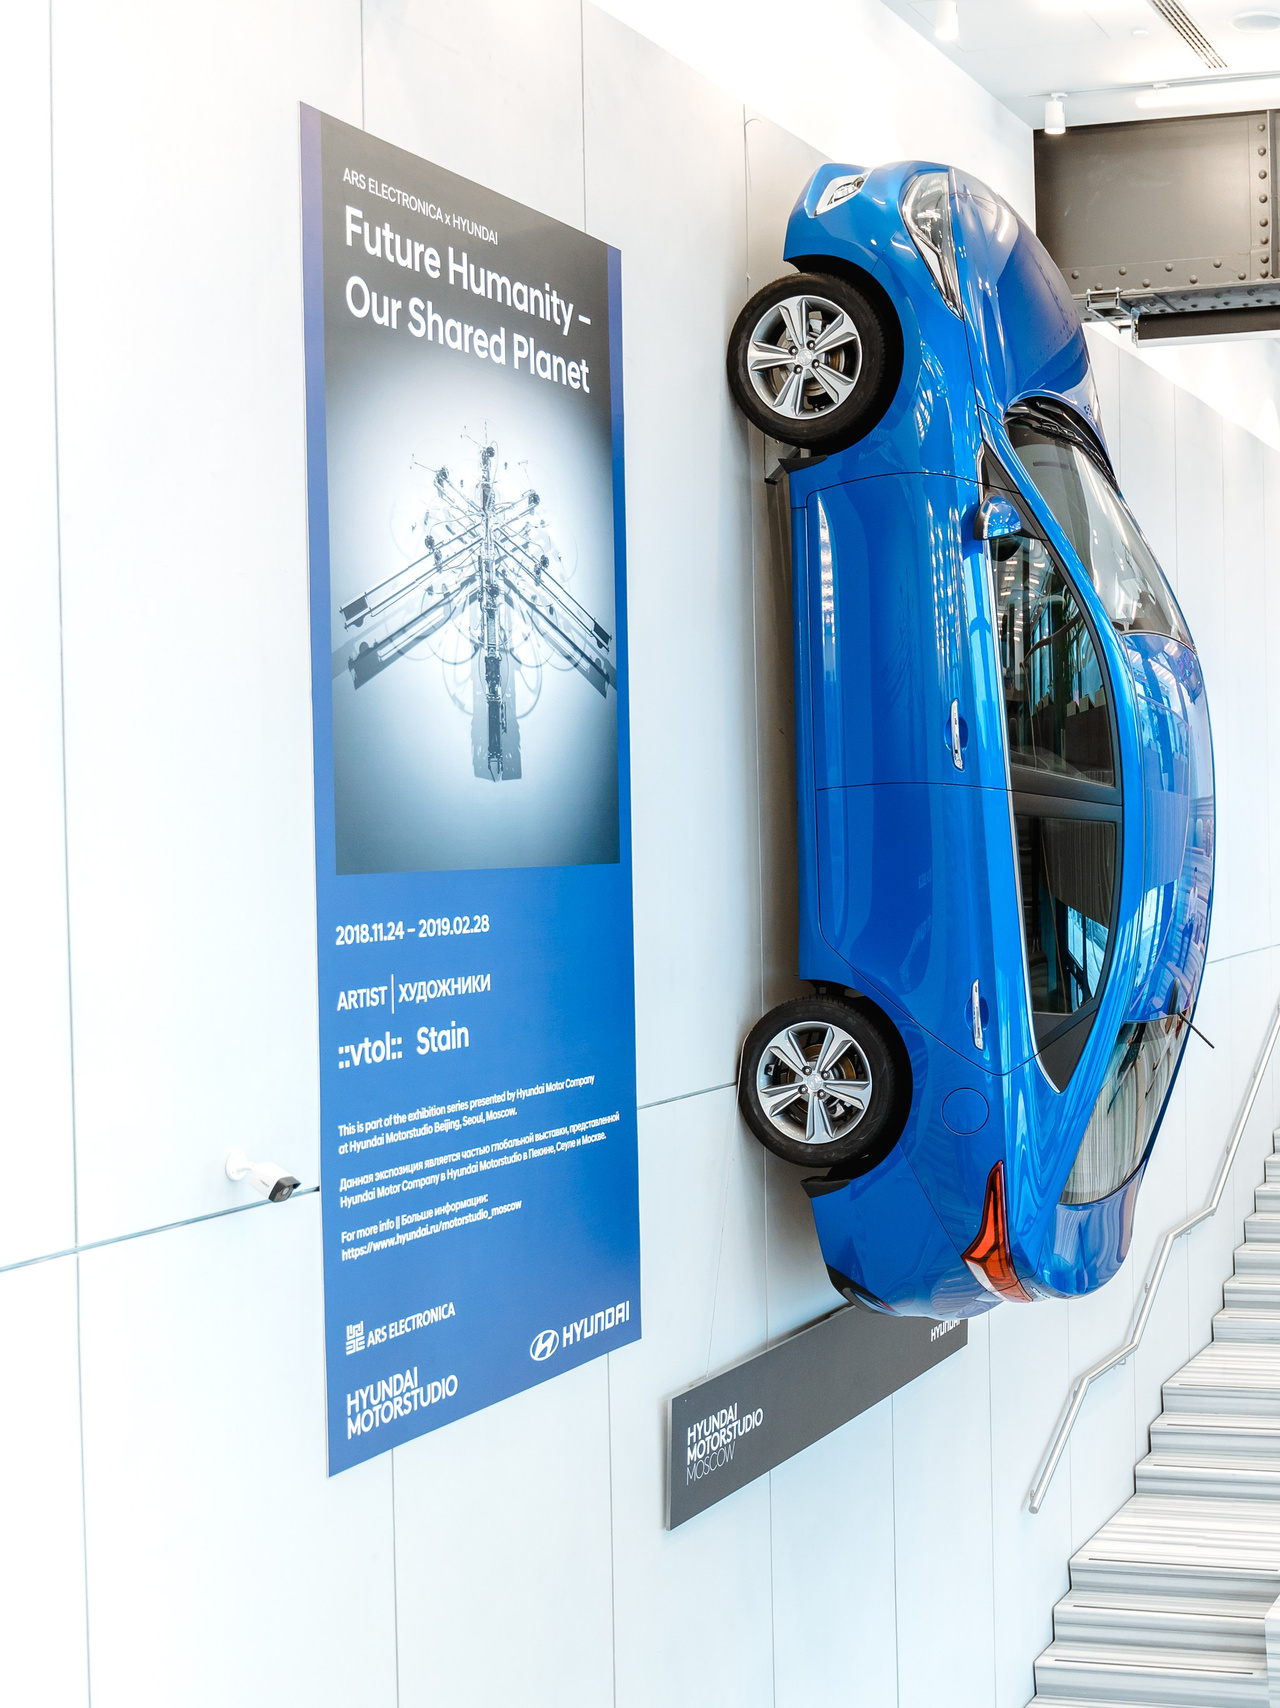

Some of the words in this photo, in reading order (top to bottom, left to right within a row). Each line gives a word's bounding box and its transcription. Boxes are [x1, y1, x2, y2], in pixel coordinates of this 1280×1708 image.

[343, 168, 366, 189] ARS
[369, 179, 443, 222] ELECTRONICA
[453, 214, 498, 245] HYUNDAI
[345, 205, 441, 279] Future
[449, 247, 574, 335] Humanity
[345, 276, 402, 329] Our
[408, 297, 505, 365] Shared
[514, 333, 590, 393] Planet
[336, 921, 404, 945] 2018.11.24
[419, 914, 490, 939] 2019.02.28
[337, 986, 388, 1011] ARTIST
[398, 974, 491, 1004] ХУДОЖНИКИ
[416, 1021, 469, 1055] Stain
[338, 1124, 356, 1136] This
[357, 1122, 364, 1132] is
[365, 1118, 383, 1133] part
[384, 1115, 394, 1127] of
[393, 1113, 407, 1124] the
[408, 1105, 446, 1121] exhibition
[447, 1100, 468, 1114] series
[471, 1092, 506, 1109] presented
[507, 1091, 516, 1102] by
[517, 1084, 545, 1099] Hyundai
[546, 1080, 565, 1092] Motor
[565, 1075, 595, 1088] Company
[339, 1143, 348, 1154] at
[350, 1134, 384, 1153] Hyundai
[386, 1124, 433, 1144] Motorstudio
[434, 1117, 462, 1132] Beijing,
[463, 1113, 485, 1126] Seoul,
[486, 1108, 517, 1121] Moscow.
[340, 1174, 373, 1191] Данная
[375, 1161, 423, 1181] экспозиция
[424, 1152, 460, 1169] является
[462, 1145, 490, 1159] частью
[491, 1132, 535, 1152] глобальной
[536, 1125, 569, 1141] выставки,
[570, 1111, 619, 1133] представленной
[340, 1188, 375, 1208] Hyundai
[377, 1184, 402, 1198] Motor
[402, 1174, 440, 1191] Company
[441, 1173, 446, 1181] в
[447, 1162, 478, 1180] Hyundai
[479, 1152, 522, 1171] Motorstudio
[523, 1152, 528, 1160] в
[529, 1145, 556, 1158] Пекине,
[556, 1141, 575, 1153] Сеуле
[577, 1138, 581, 1146] и
[582, 1132, 606, 1145] Москве.
[342, 1232, 355, 1243] For
[357, 1225, 378, 1239] more
[379, 1219, 394, 1232] info
[401, 1209, 433, 1225] Больше
[435, 1194, 488, 1216] информации:
[342, 1201, 522, 1261] https://www.hyundai.ru/motorstudio_moscow
[367, 1325, 387, 1348] ARS
[389, 1302, 456, 1336] ELECTRONICA
[563, 1301, 630, 1348] HYUNDAI
[347, 1367, 418, 1416] HYUNDAI
[347, 1375, 458, 1440] MOTORSTUDIO
[687, 1403, 738, 1444] HYUNDAI
[687, 1408, 764, 1465] MOTORSTUDIO
[686, 1441, 736, 1485] MOSCOW
